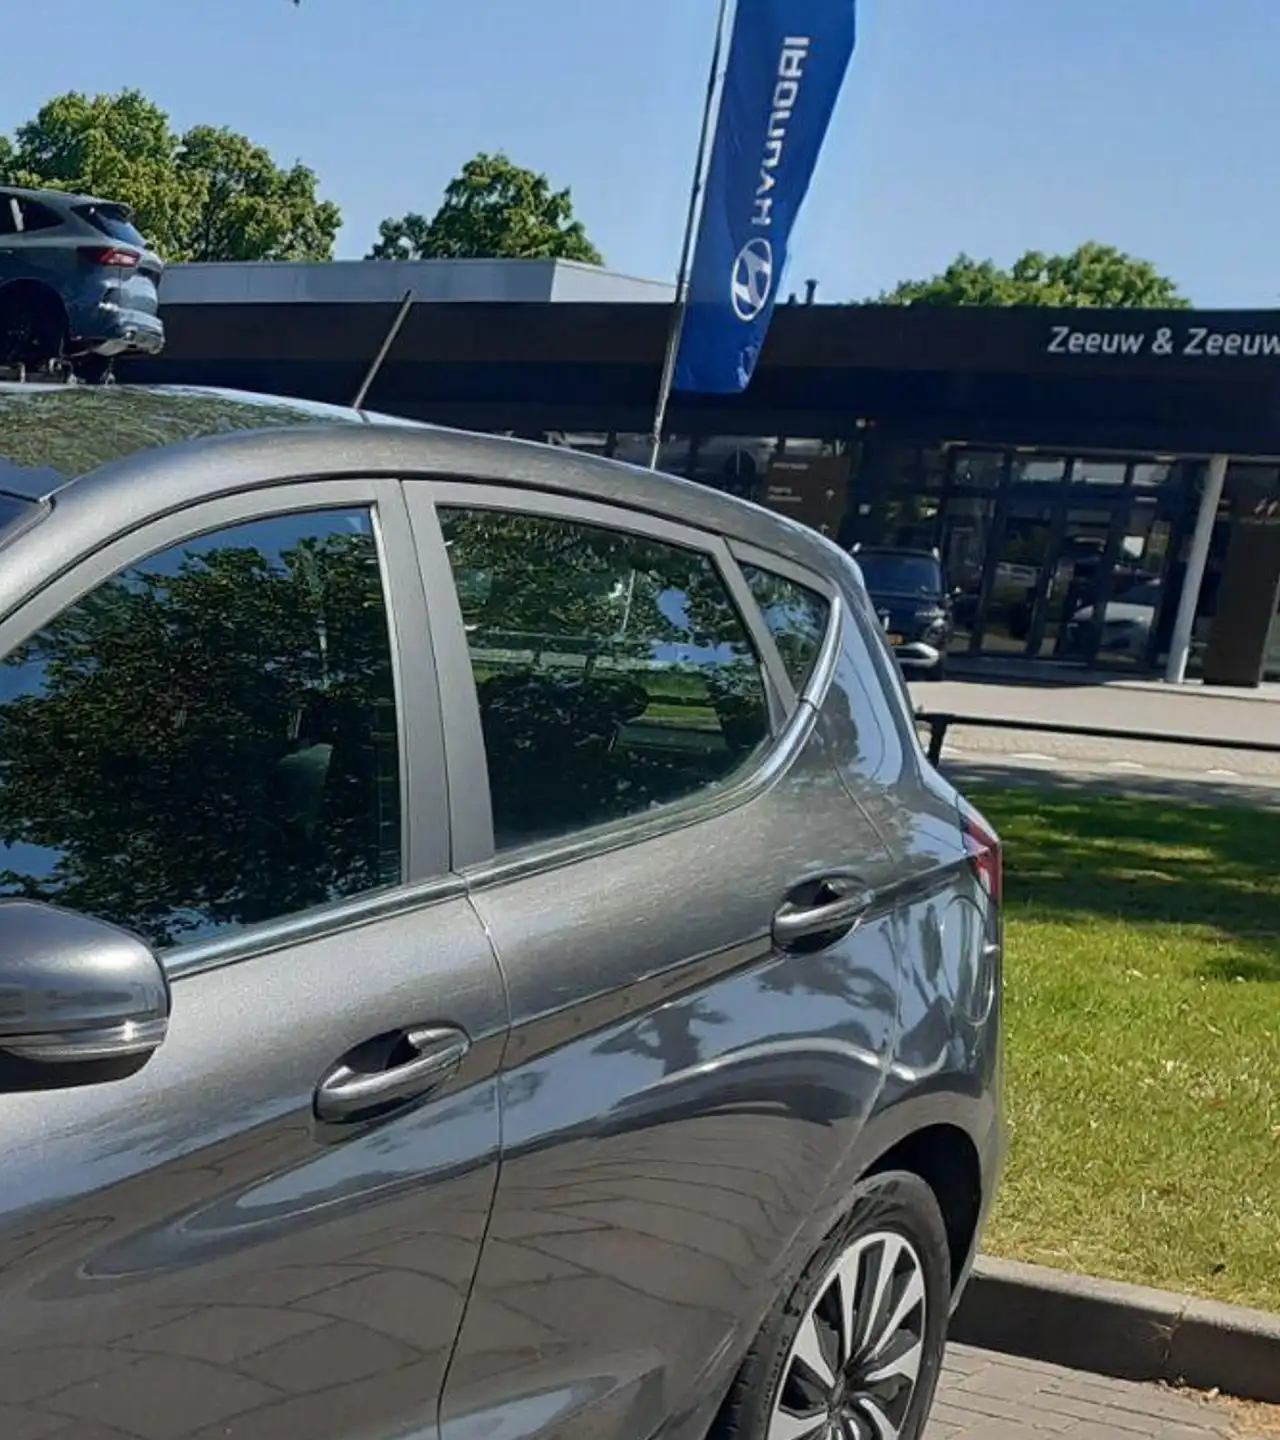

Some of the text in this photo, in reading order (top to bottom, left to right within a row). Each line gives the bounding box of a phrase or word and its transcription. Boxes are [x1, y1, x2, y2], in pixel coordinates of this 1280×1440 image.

[751, 36, 810, 226] HYUNDAI
[1047, 326, 1145, 355] Zeeuw
[1151, 327, 1175, 355] &
